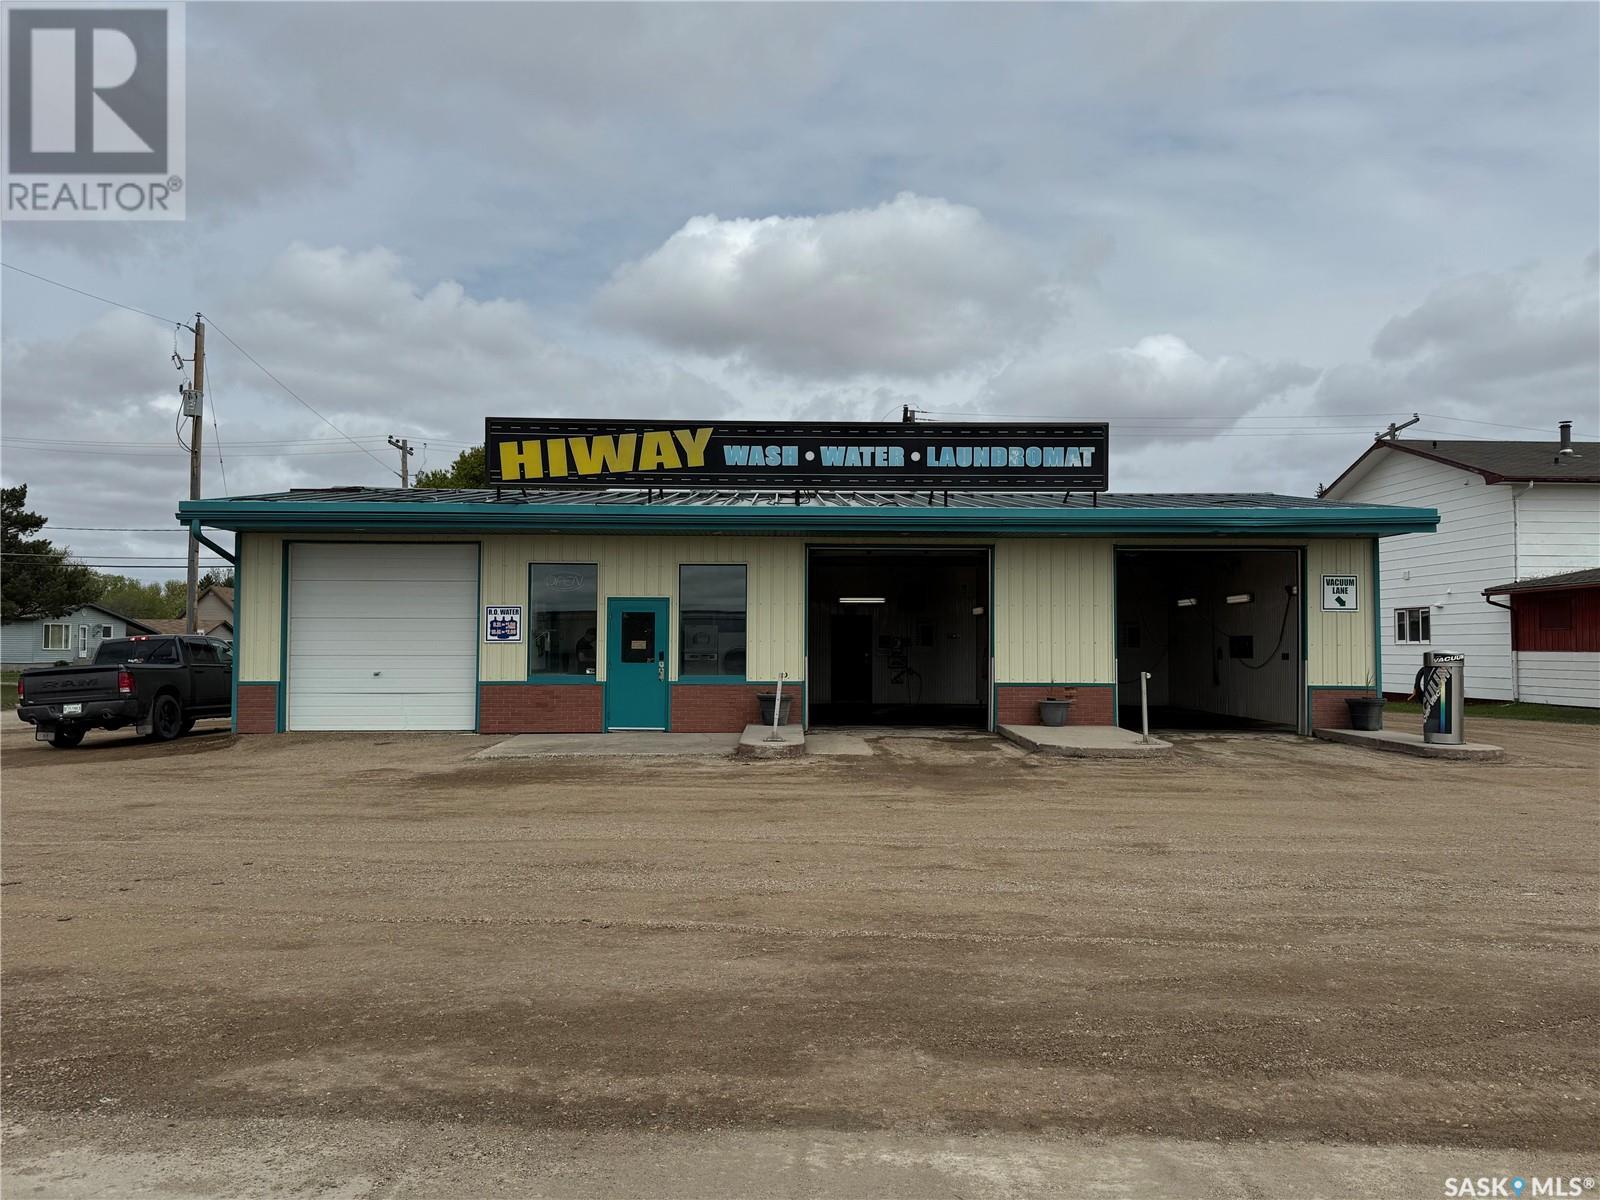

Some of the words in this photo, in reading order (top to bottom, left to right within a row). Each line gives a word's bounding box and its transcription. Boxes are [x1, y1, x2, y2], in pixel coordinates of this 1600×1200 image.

[499, 427, 714, 481] HIWAY
[723, 445, 799, 466] WASH
[819, 446, 905, 467] WATER
[926, 446, 1096, 468] LAUNDROMAT
[1325, 578, 1355, 586] VACUUM
[1332, 586, 1349, 595] LANE
[499, 608, 520, 616] WATER
